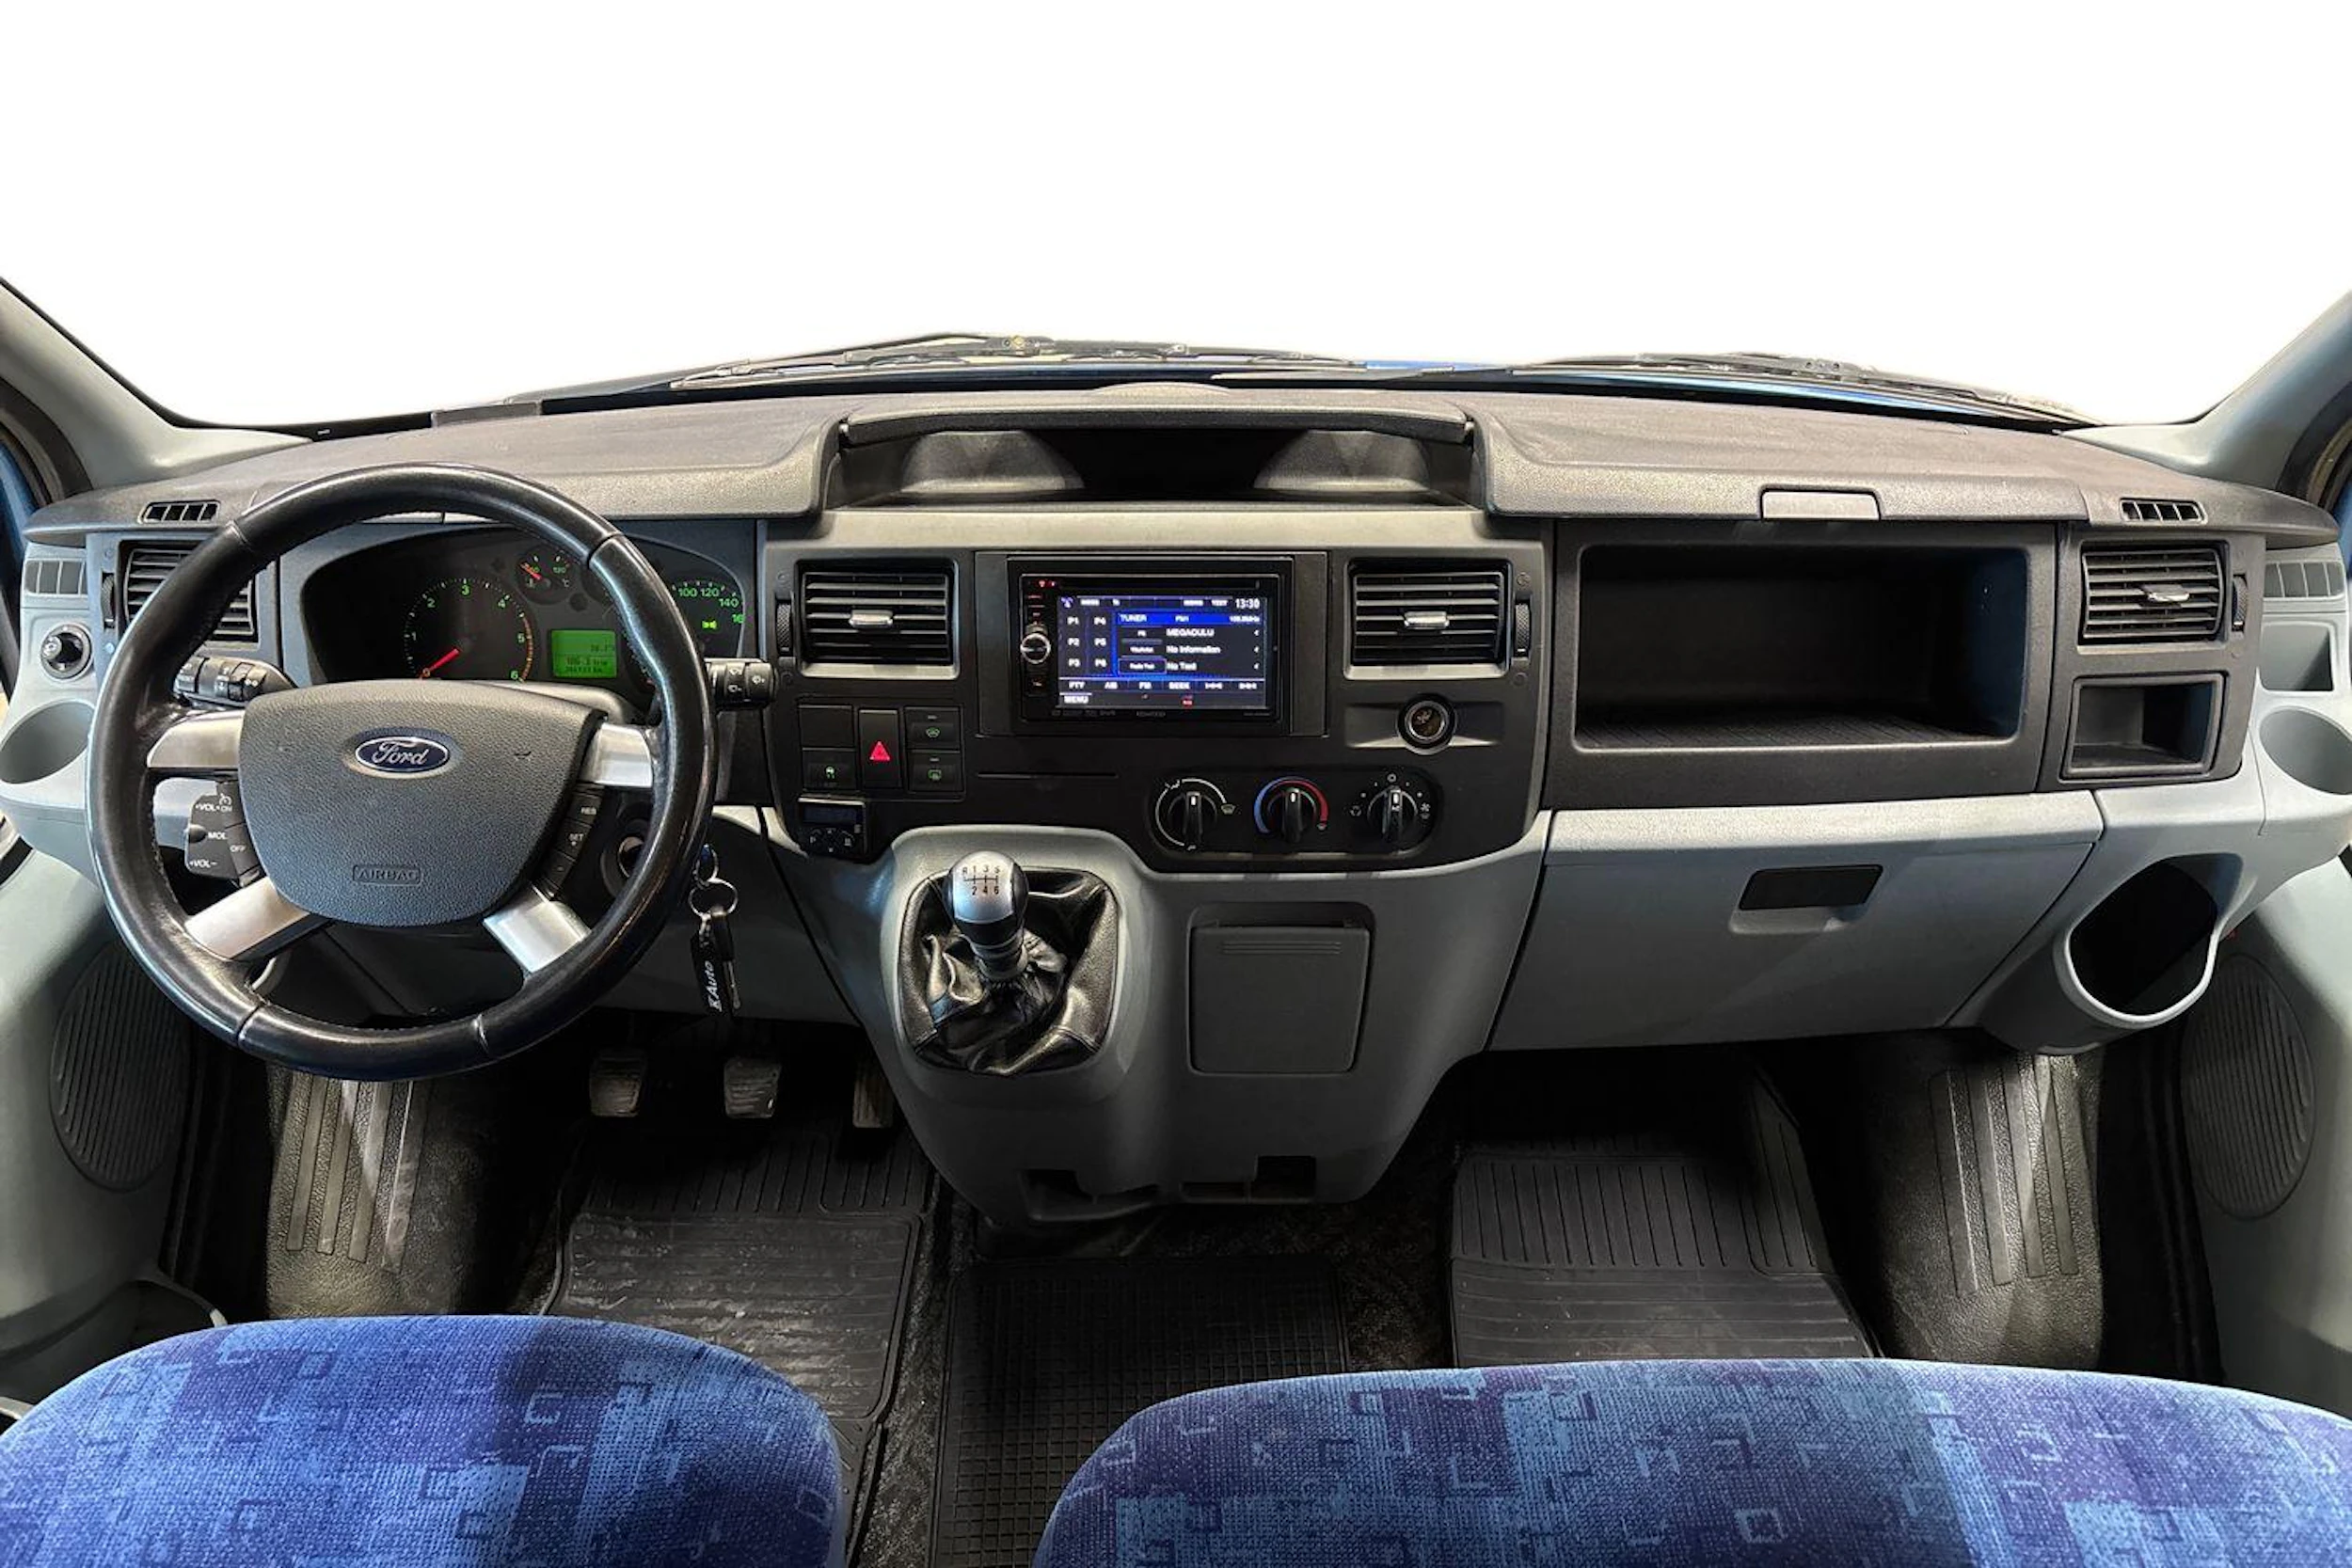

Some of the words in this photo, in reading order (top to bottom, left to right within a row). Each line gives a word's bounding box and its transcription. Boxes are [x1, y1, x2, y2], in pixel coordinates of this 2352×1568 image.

[461, 584, 471, 595] 3
[678, 588, 698, 597] 100
[700, 588, 720, 597] 120
[427, 597, 436, 609] 2
[498, 598, 507, 609] 4
[719, 598, 740, 609] 140
[1234, 598, 1261, 610] 13:30
[411, 631, 417, 641] 1
[517, 632, 525, 643] 5
[510, 670, 519, 680] 6
[372, 741, 429, 766] Ford
[230, 844, 246, 853] OFF
[358, 865, 419, 881] AIRBAG
[971, 885, 977, 895] 2
[982, 885, 989, 895] 4
[993, 885, 999, 895] 6
